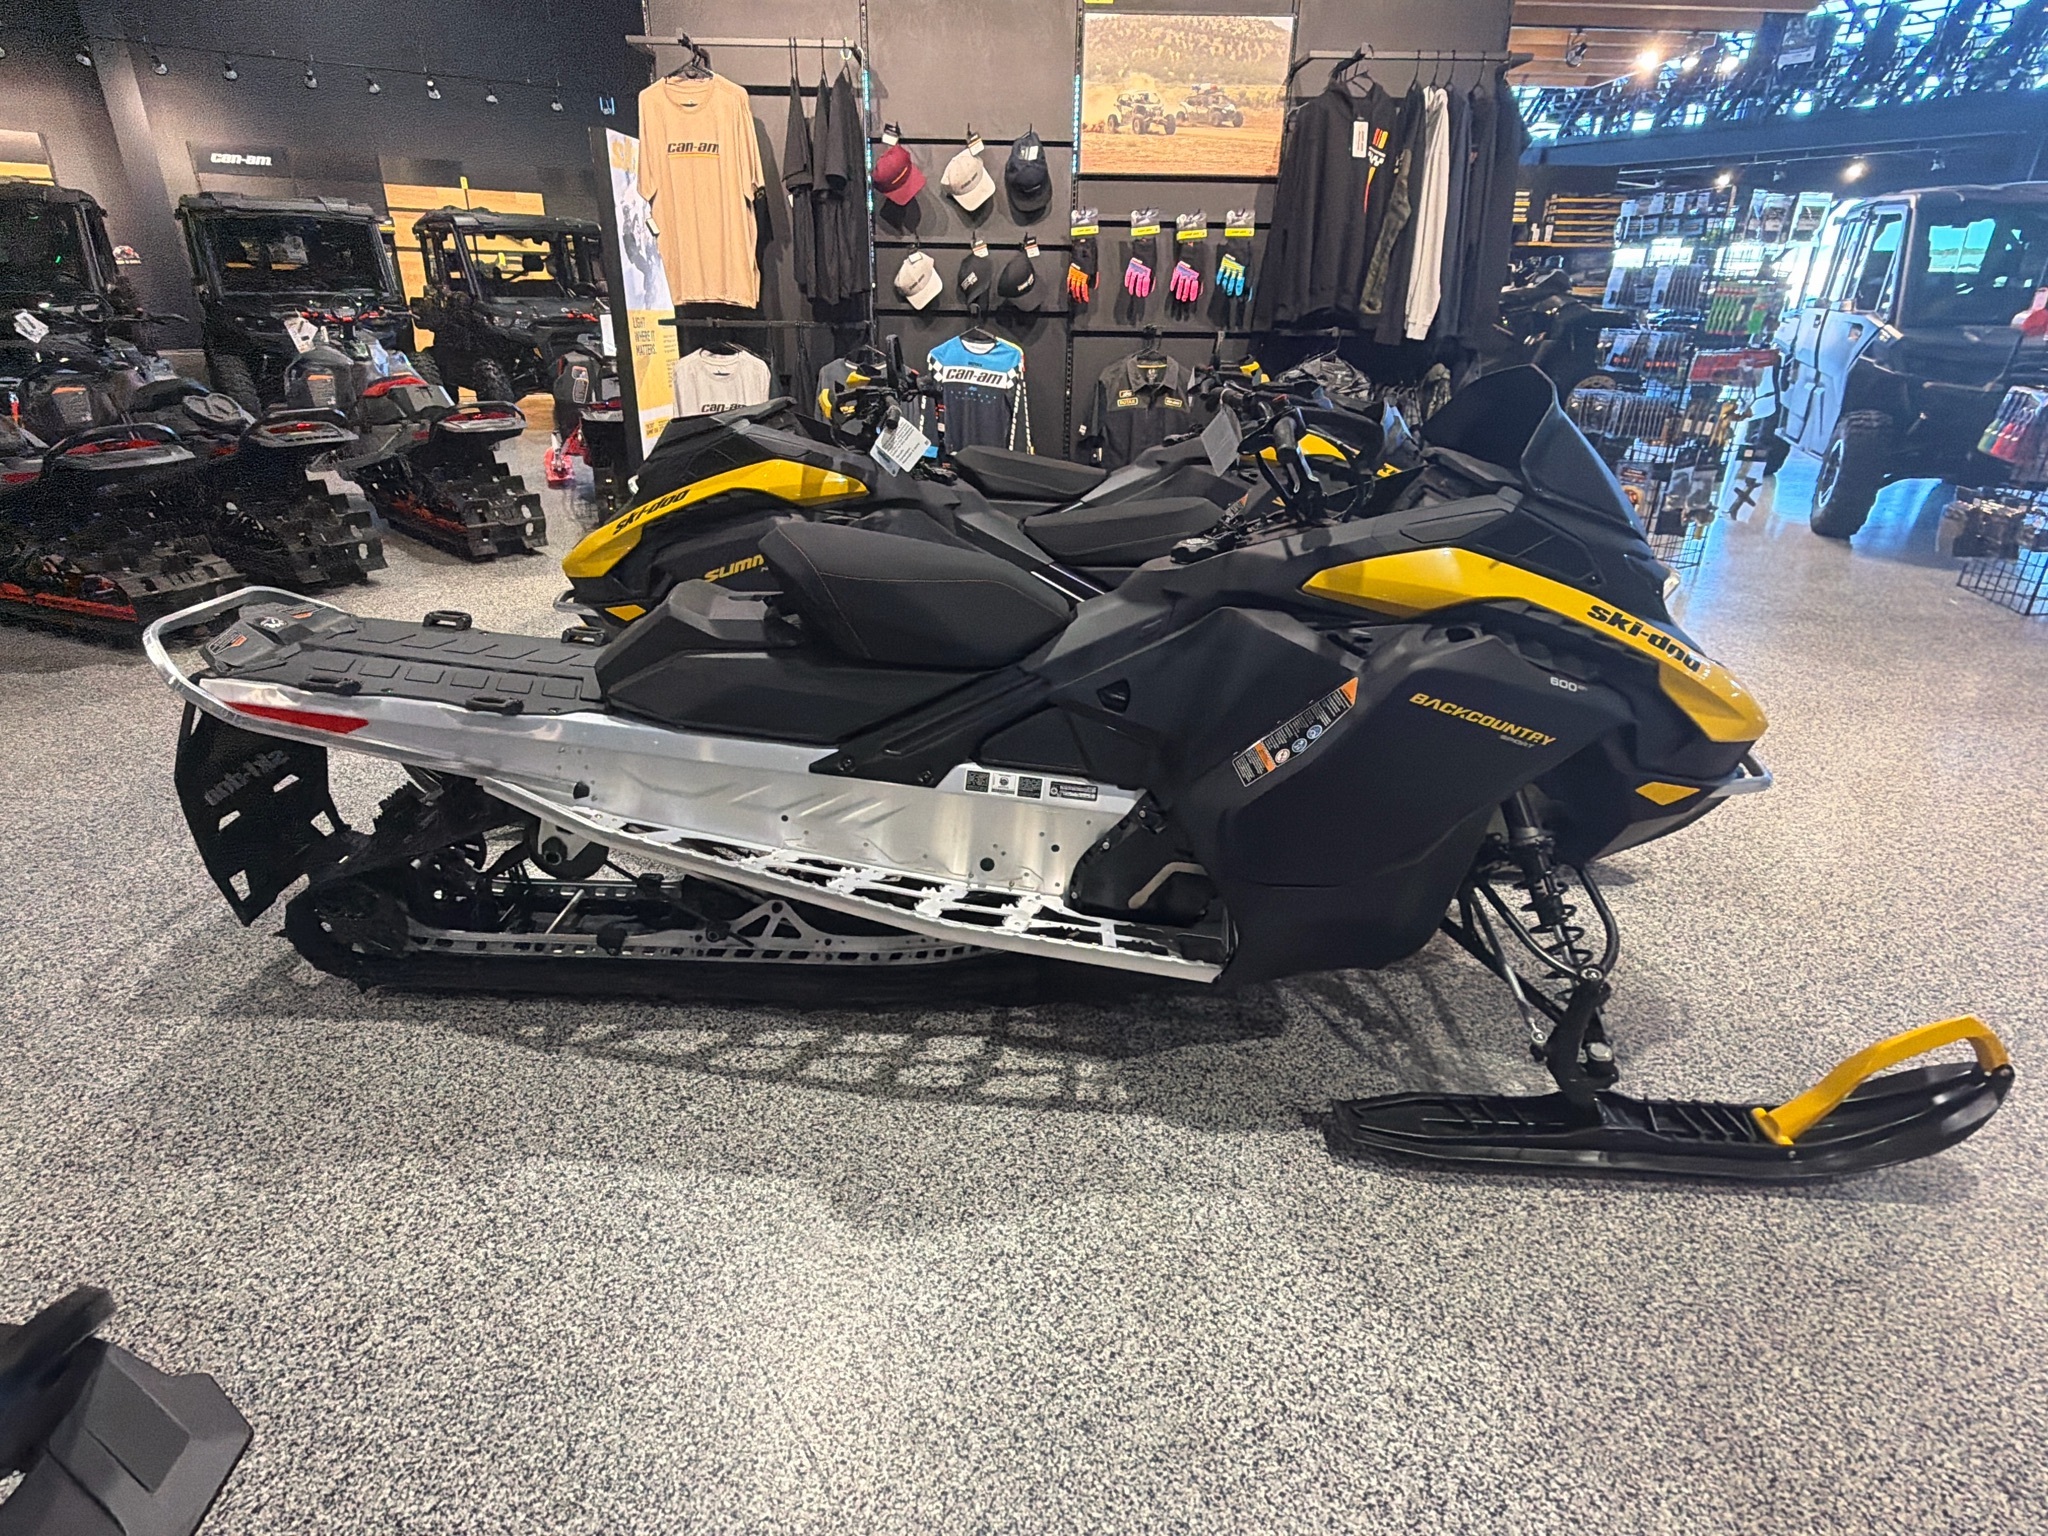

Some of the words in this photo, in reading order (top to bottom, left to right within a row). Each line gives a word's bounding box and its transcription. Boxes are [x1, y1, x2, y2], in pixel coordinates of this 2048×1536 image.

[667, 142, 719, 153] can-am
[210, 153, 272, 166] can-am
[945, 368, 1003, 385] can-am
[612, 489, 690, 535] ski-doo
[1587, 605, 1700, 672] ski-doo
[1550, 677, 1577, 692] 600
[1409, 693, 1556, 746] BACKCOUNTRY
